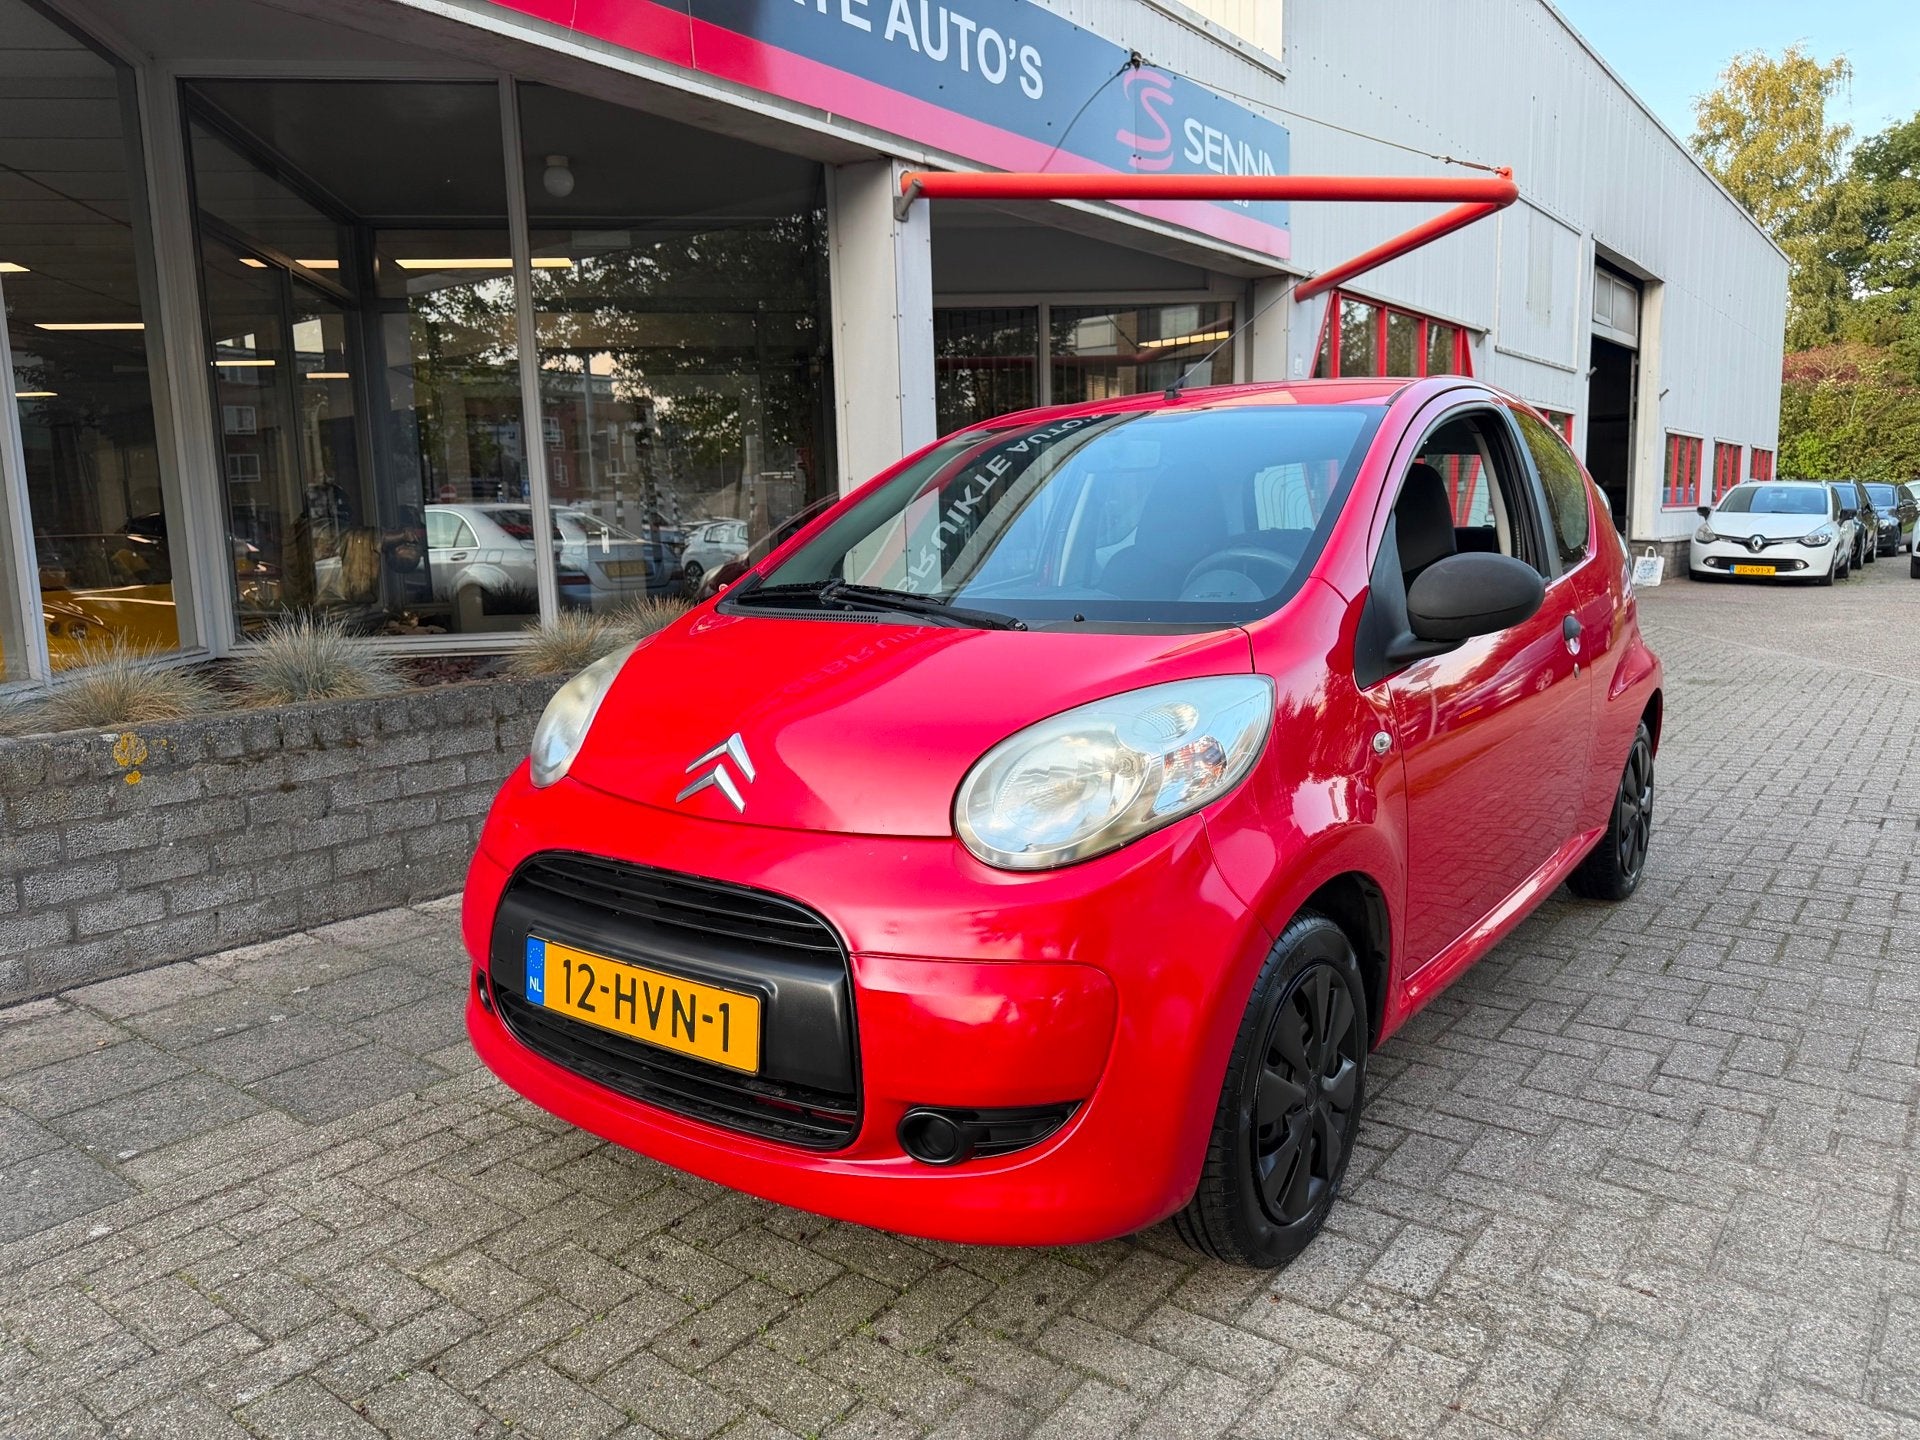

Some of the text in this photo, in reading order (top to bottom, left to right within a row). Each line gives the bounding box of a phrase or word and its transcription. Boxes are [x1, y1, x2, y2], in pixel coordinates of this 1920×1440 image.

[884, 0, 1044, 99] AUTO'S
[529, 975, 542, 993] NL
[562, 958, 730, 1053] 12-HVN-1
